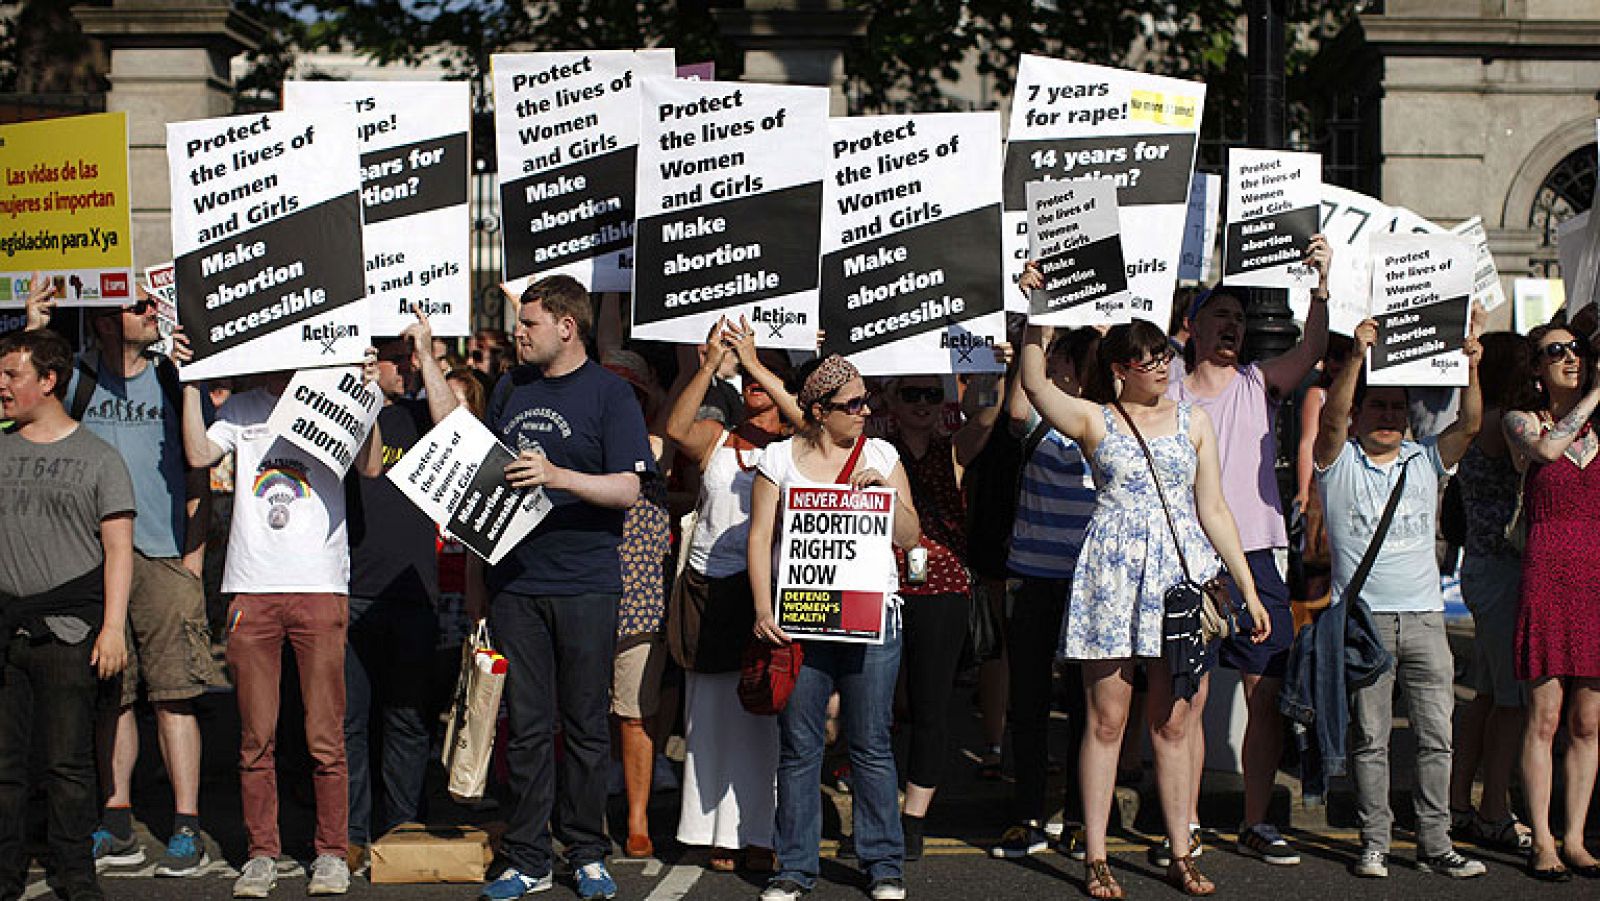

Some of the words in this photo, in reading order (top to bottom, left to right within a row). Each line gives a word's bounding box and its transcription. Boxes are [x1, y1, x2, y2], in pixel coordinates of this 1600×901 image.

[512, 56, 592, 92] Protect
[517, 98, 550, 119] the
[556, 82, 605, 108] lives
[610, 70, 633, 92] of
[659, 89, 743, 122] Protect
[1028, 84, 1041, 101] 7
[1048, 82, 1109, 105] years
[358, 114, 397, 142] pe!
[1025, 108, 1060, 127] for
[1068, 103, 1128, 126] rape!
[187, 114, 271, 158] Protect
[519, 113, 598, 146] Women
[659, 132, 696, 151] the
[702, 118, 755, 143] lives
[761, 108, 786, 130] of
[833, 119, 916, 159] Protect
[190, 164, 226, 187] the
[233, 142, 284, 171] lives
[291, 125, 315, 150] of
[359, 156, 403, 182] ears
[408, 147, 445, 169] for
[523, 150, 561, 173] and
[568, 133, 618, 159] Girls
[660, 150, 745, 180] Women
[835, 165, 871, 187] the
[878, 146, 930, 175] lives
[935, 134, 959, 158] of
[1031, 149, 1057, 170] 14
[1064, 147, 1128, 171] years
[1134, 141, 1170, 161] for
[6, 167, 25, 186] Las
[28, 163, 58, 184] vidas
[61, 160, 76, 180] de
[79, 159, 99, 180] las
[1240, 159, 1282, 175] Protect
[1241, 180, 1259, 190] the
[1262, 173, 1287, 184] lives
[1290, 169, 1301, 180] of
[56, 190, 115, 215] importan
[194, 175, 278, 213] Women
[362, 176, 420, 207] tion?
[526, 175, 587, 204] Make
[661, 184, 702, 209] and
[710, 174, 764, 199] Girls
[837, 179, 922, 216] Women
[1036, 190, 1074, 210] Protect
[1241, 190, 1284, 203] Women
[198, 217, 239, 243] and
[248, 195, 299, 222] Girls
[531, 196, 622, 233] abortion
[840, 218, 881, 245] and
[889, 202, 942, 229] Girls
[1037, 214, 1053, 226] the
[1056, 206, 1081, 220] lives
[1083, 198, 1096, 211] of
[1241, 206, 1263, 219] and
[1267, 202, 1292, 213] Girls
[662, 215, 726, 243] Make
[1037, 222, 1080, 241] Women
[1241, 221, 1275, 236] Make
[1, 229, 58, 257] egislación
[62, 232, 88, 254] para
[90, 228, 101, 246] X
[102, 230, 117, 252] ya
[1041, 243, 1060, 257] and
[1064, 234, 1090, 250] Girls
[1241, 235, 1292, 251] abortion
[202, 241, 266, 277] Make
[664, 241, 761, 276] abortion
[843, 246, 907, 278] Make
[1043, 257, 1076, 273] Make
[1127, 258, 1167, 278] girls
[1385, 250, 1430, 266] Protect
[1386, 271, 1405, 282] the
[1408, 265, 1436, 278] lives
[1439, 259, 1453, 271] of
[206, 260, 304, 310] abortion
[381, 270, 413, 292] and
[420, 262, 459, 287] girls
[665, 270, 780, 308] accessible
[847, 268, 945, 310] abortion
[1046, 269, 1096, 291] abortion
[1385, 281, 1432, 296] Women
[1047, 282, 1107, 308] accessible
[1386, 299, 1409, 311] and
[1412, 293, 1440, 306] Girls
[210, 286, 326, 342] accessible
[752, 306, 807, 325] Action
[849, 296, 966, 343] accessible
[1386, 313, 1420, 328] Make
[302, 324, 359, 342] Action
[940, 331, 995, 349] Action
[1386, 326, 1436, 345] abortion
[1386, 340, 1445, 361] accessible
[793, 491, 838, 508] NEVER
[839, 493, 884, 510] AGAIN
[789, 513, 887, 536] ABORTION
[789, 539, 857, 561] RIGHTS
[788, 564, 836, 586] NOW
[783, 602, 840, 613] WOMEN'S
[784, 592, 830, 601] DEFEND
[782, 612, 826, 623] HEALTH
